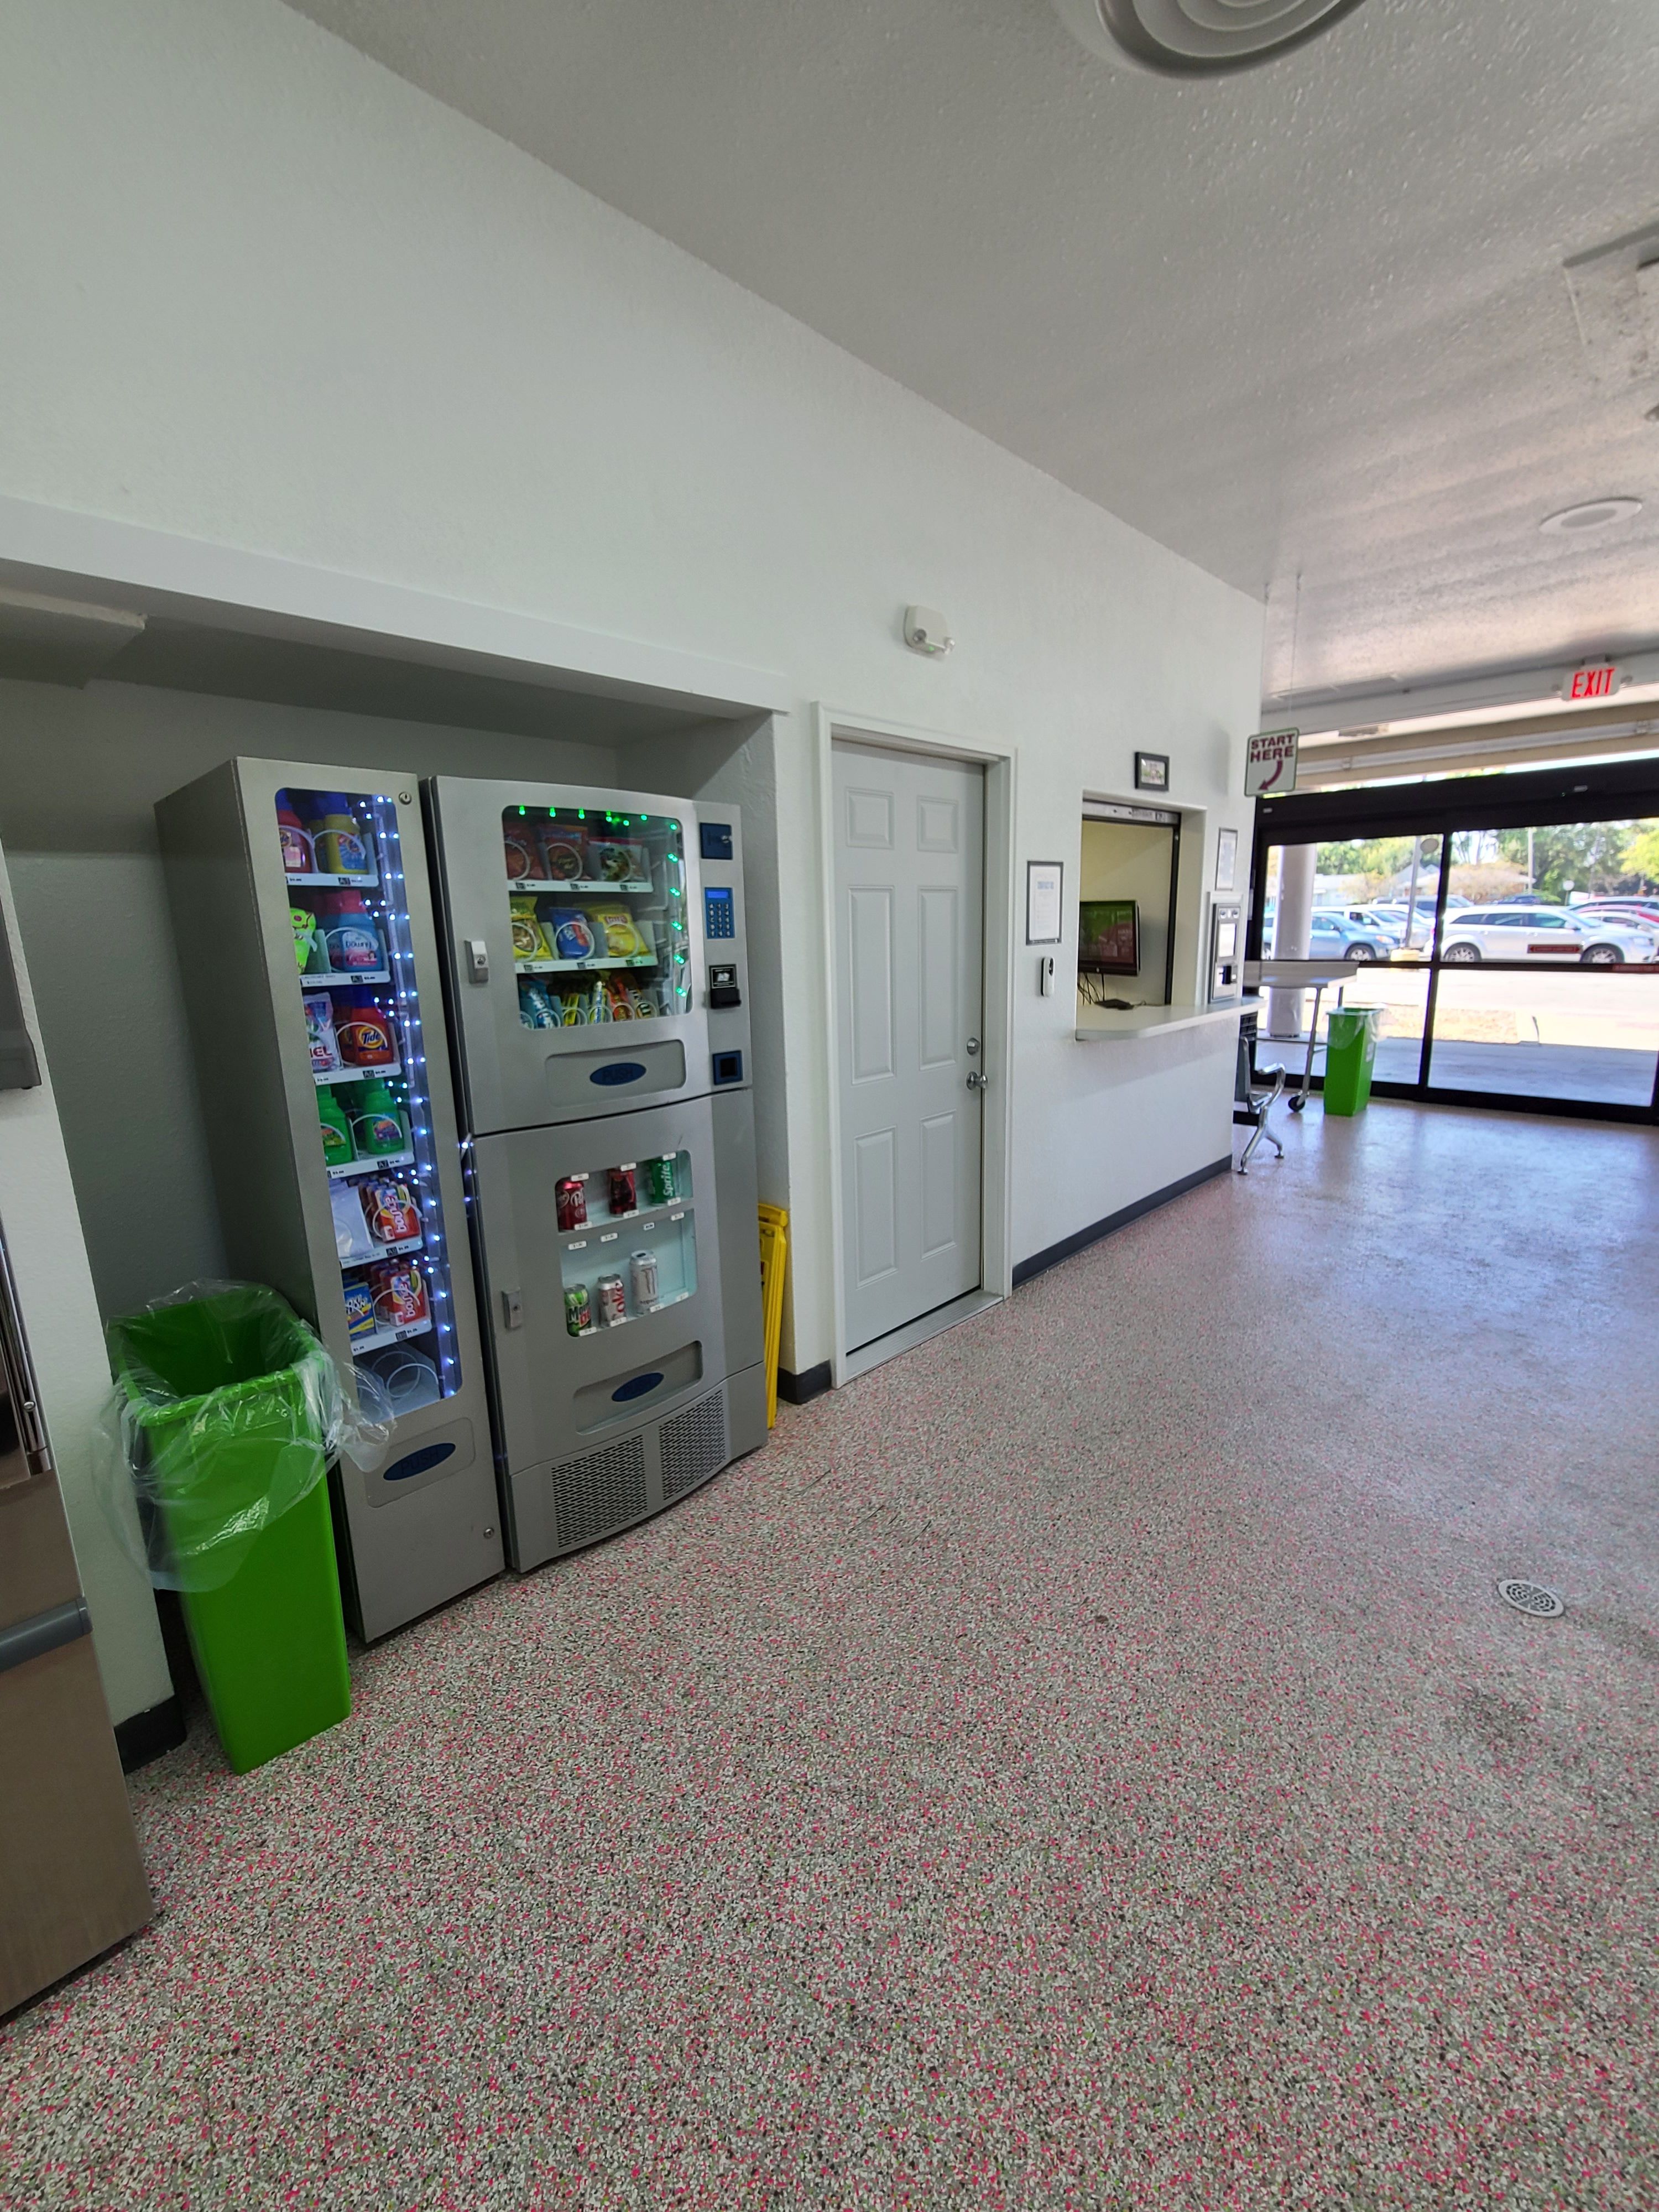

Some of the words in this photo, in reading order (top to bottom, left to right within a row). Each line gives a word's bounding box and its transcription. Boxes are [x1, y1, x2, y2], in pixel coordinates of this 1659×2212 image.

[1572, 667, 1616, 699] EXIT
[1250, 734, 1295, 750] START
[1250, 746, 1295, 762] HERE
[345, 940, 372, 950] Downy
[363, 1031, 382, 1044] Tide
[661, 1162, 674, 1196] Sprite
